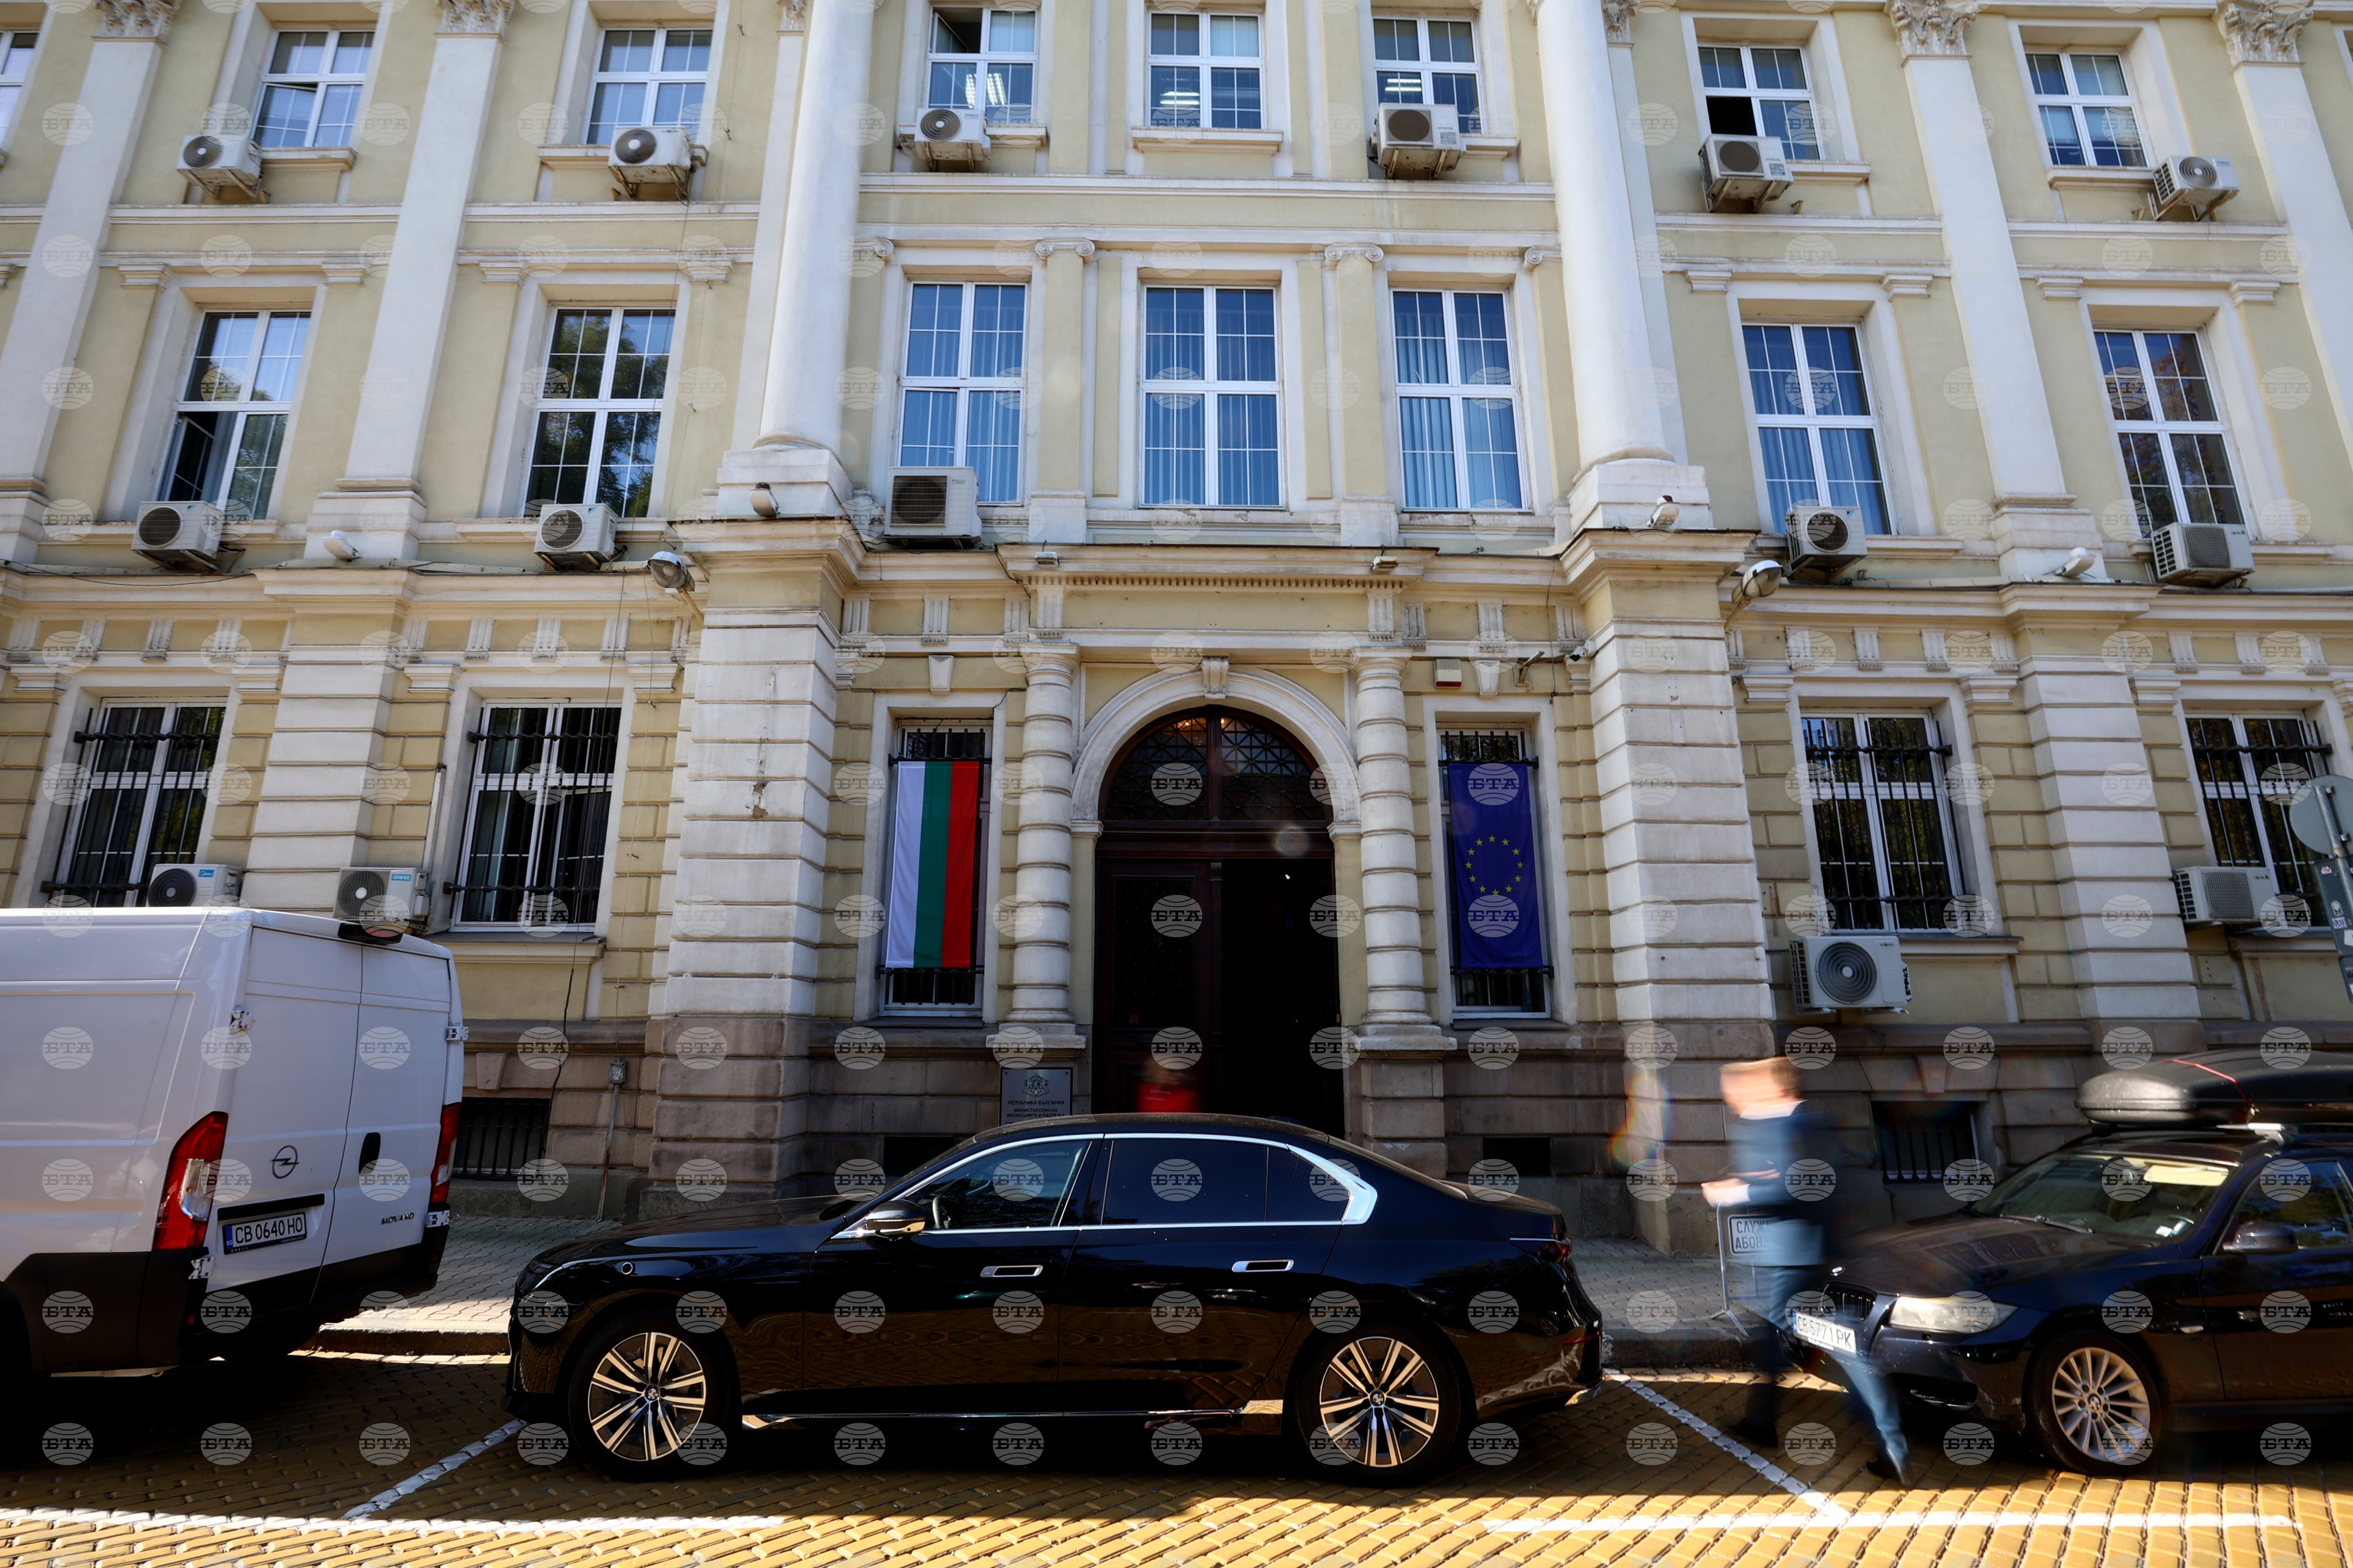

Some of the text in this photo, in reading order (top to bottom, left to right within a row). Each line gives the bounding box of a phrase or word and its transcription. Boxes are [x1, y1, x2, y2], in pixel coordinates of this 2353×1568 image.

[235, 1217, 303, 1244] CB 0640 HO
[381, 1213, 415, 1225] MOVANO
[1798, 1316, 1852, 1349] CB 5771 PK
